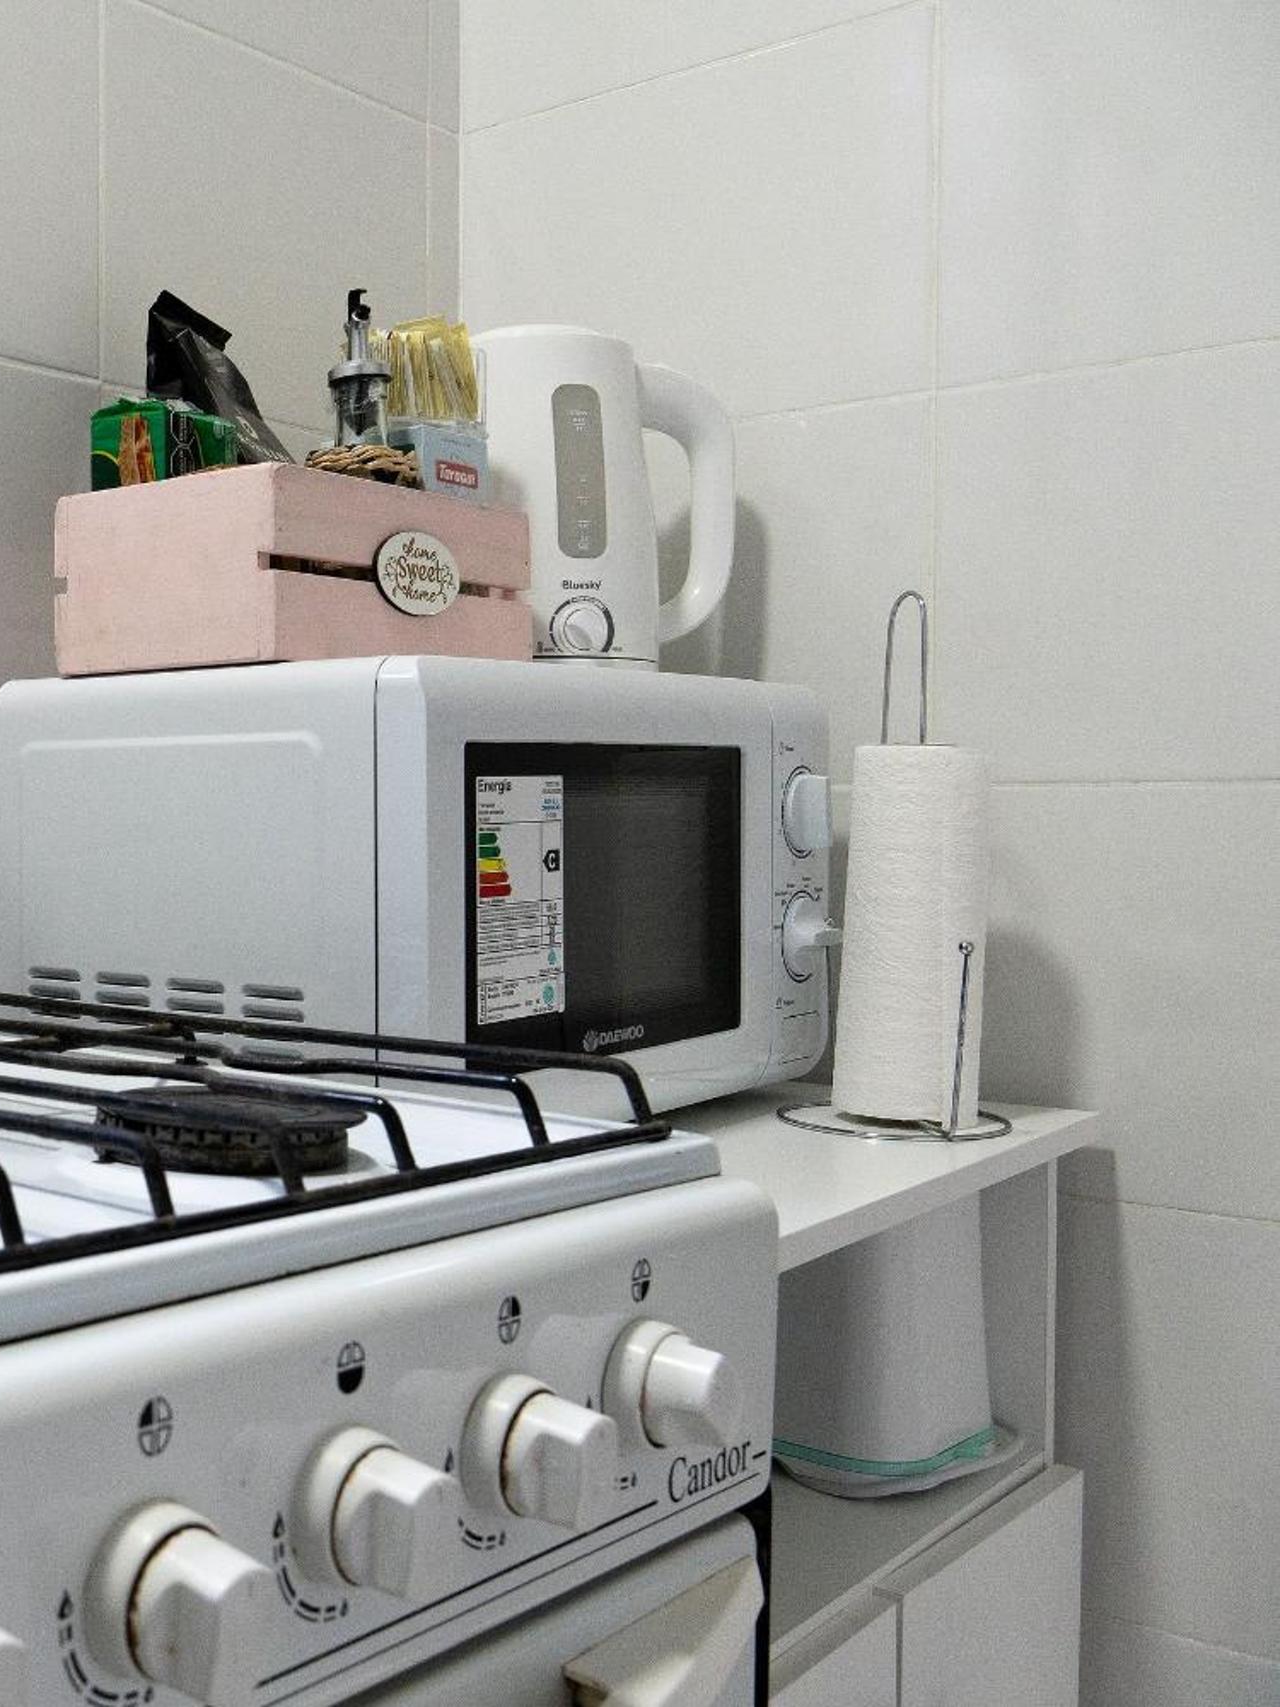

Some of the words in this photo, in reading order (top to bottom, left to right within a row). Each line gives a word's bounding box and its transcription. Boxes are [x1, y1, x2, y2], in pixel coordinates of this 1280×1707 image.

[396, 555, 443, 583] Sweet
[562, 580, 602, 591] Bluesky
[599, 1024, 645, 1045] DAEWOO
[668, 1441, 751, 1503] Candor
